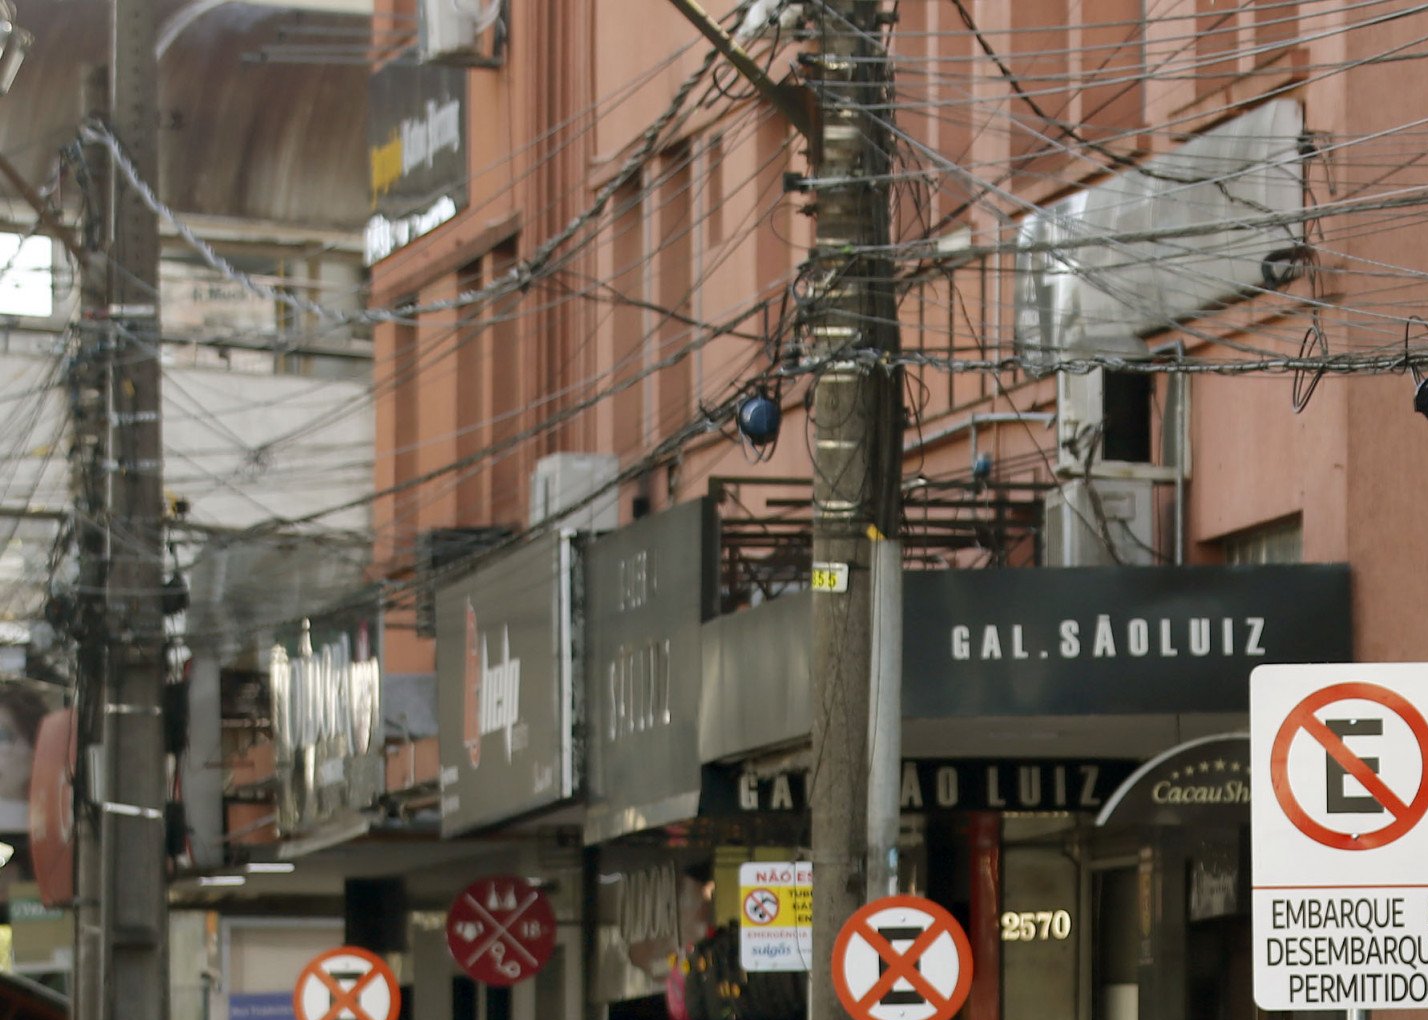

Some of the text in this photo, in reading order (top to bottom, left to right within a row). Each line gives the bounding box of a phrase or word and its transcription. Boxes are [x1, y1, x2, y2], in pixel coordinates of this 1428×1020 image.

[740, 761, 1101, 809] GA ÃO LUIZ
[756, 868, 792, 882] NÃO
[1001, 909, 1071, 941] 2570
[1272, 898, 1405, 933] EMBARQUE
[1289, 973, 1428, 1003] PERMITIDO
